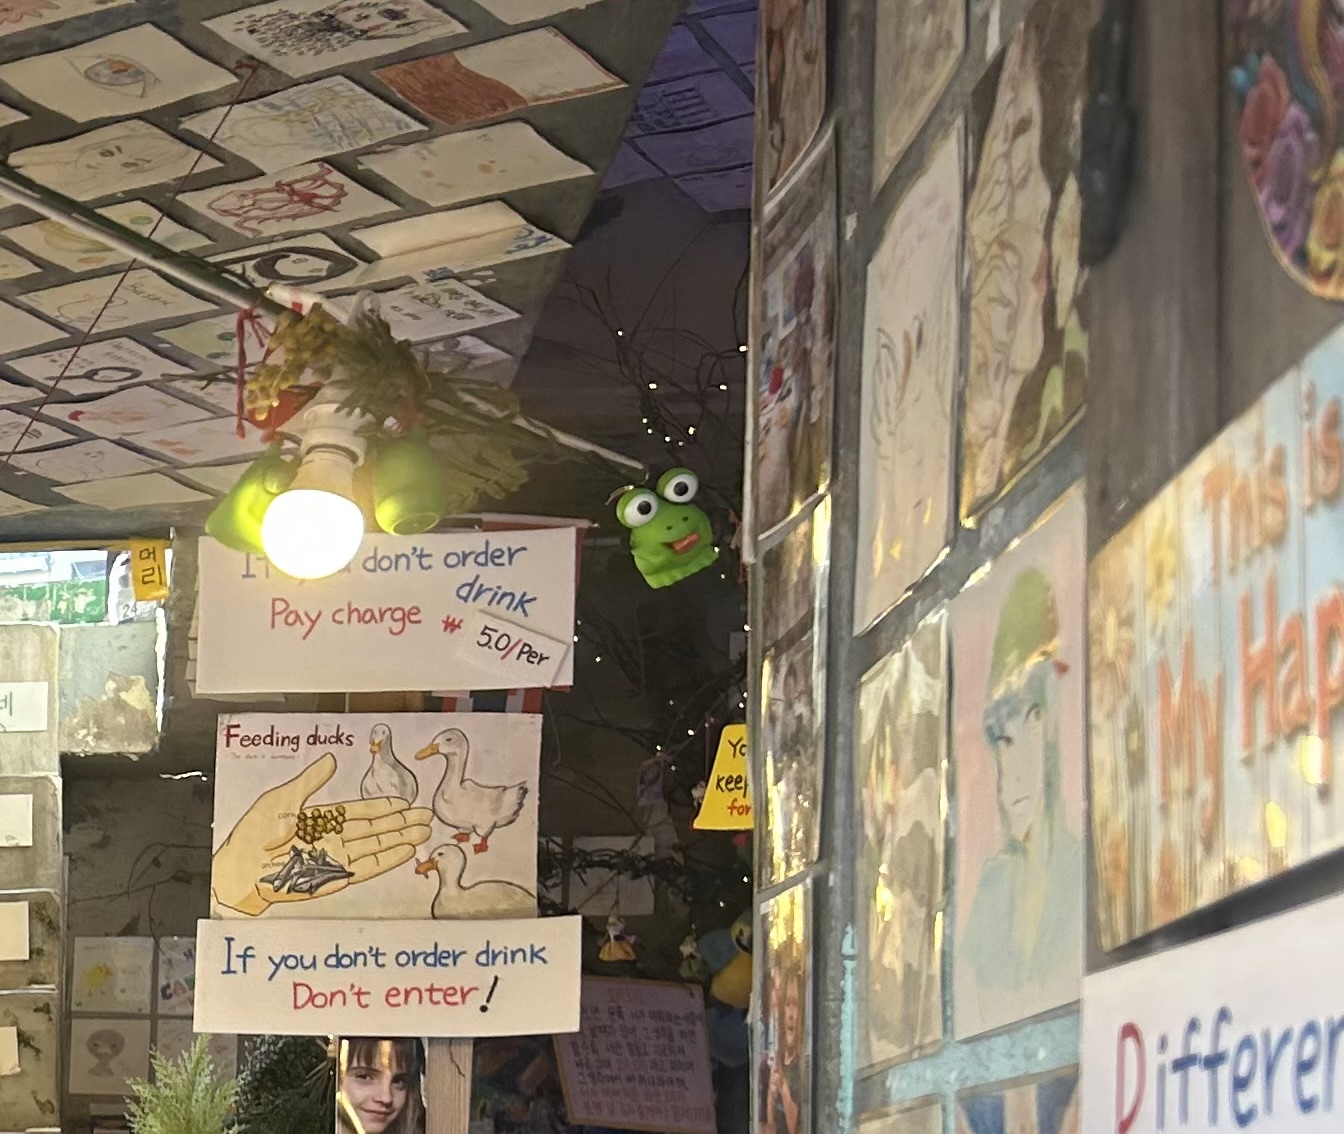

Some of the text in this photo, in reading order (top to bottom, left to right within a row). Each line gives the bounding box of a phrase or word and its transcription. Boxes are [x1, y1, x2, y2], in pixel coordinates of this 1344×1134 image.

[138, 545, 163, 587] 머리
[362, 539, 528, 573] don't order
[455, 575, 538, 618] drink
[269, 597, 324, 641] Pay
[331, 600, 422, 637] charge
[223, 723, 355, 752] Feeding ducks
[221, 936, 548, 982] If you don't order drink
[291, 981, 373, 1011] Don't
